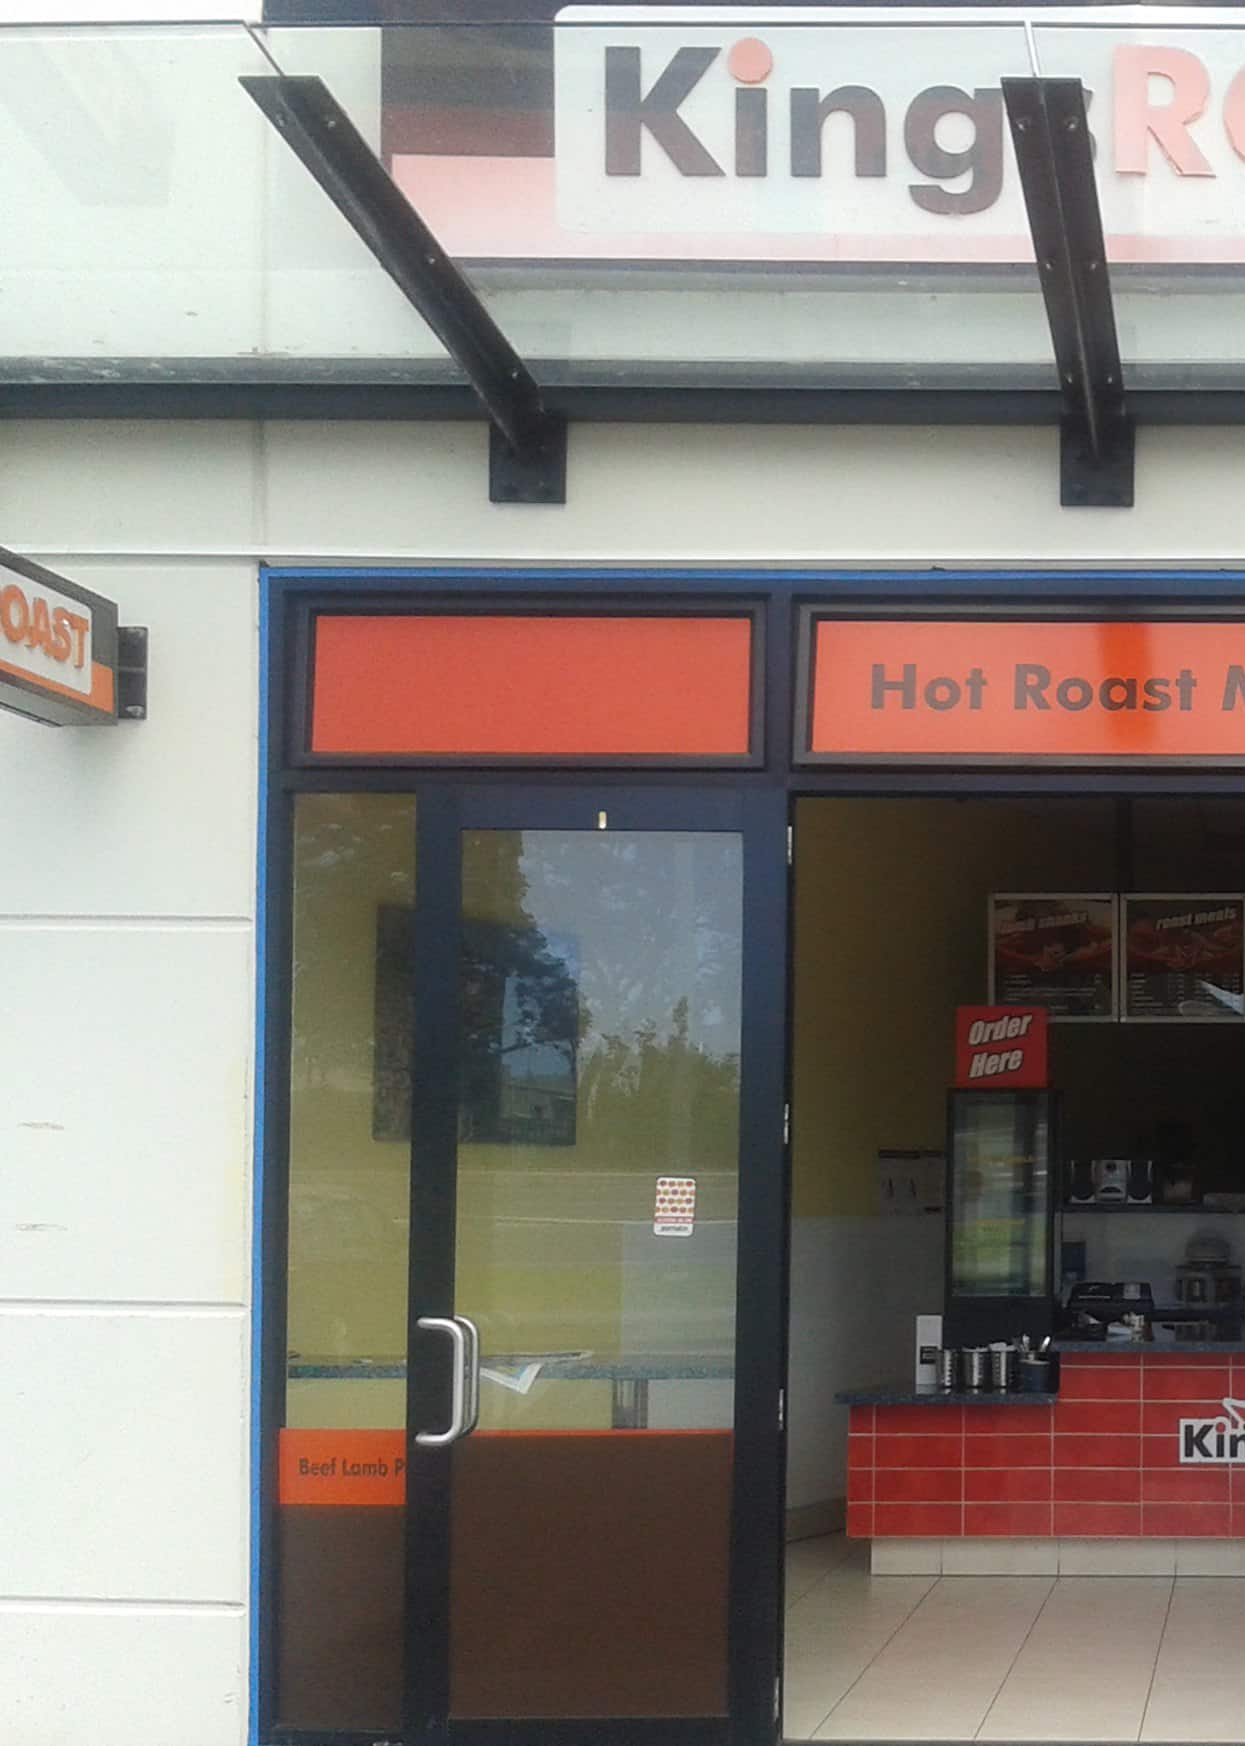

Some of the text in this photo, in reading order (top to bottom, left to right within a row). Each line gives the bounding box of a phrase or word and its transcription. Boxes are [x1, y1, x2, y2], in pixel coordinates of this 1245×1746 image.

[870, 663, 988, 712] Hot
[1013, 663, 1198, 712] Roast
[968, 1014, 1033, 1079] Order Here
[298, 1457, 337, 1476] Beef
[342, 1457, 389, 1477] Lamb
